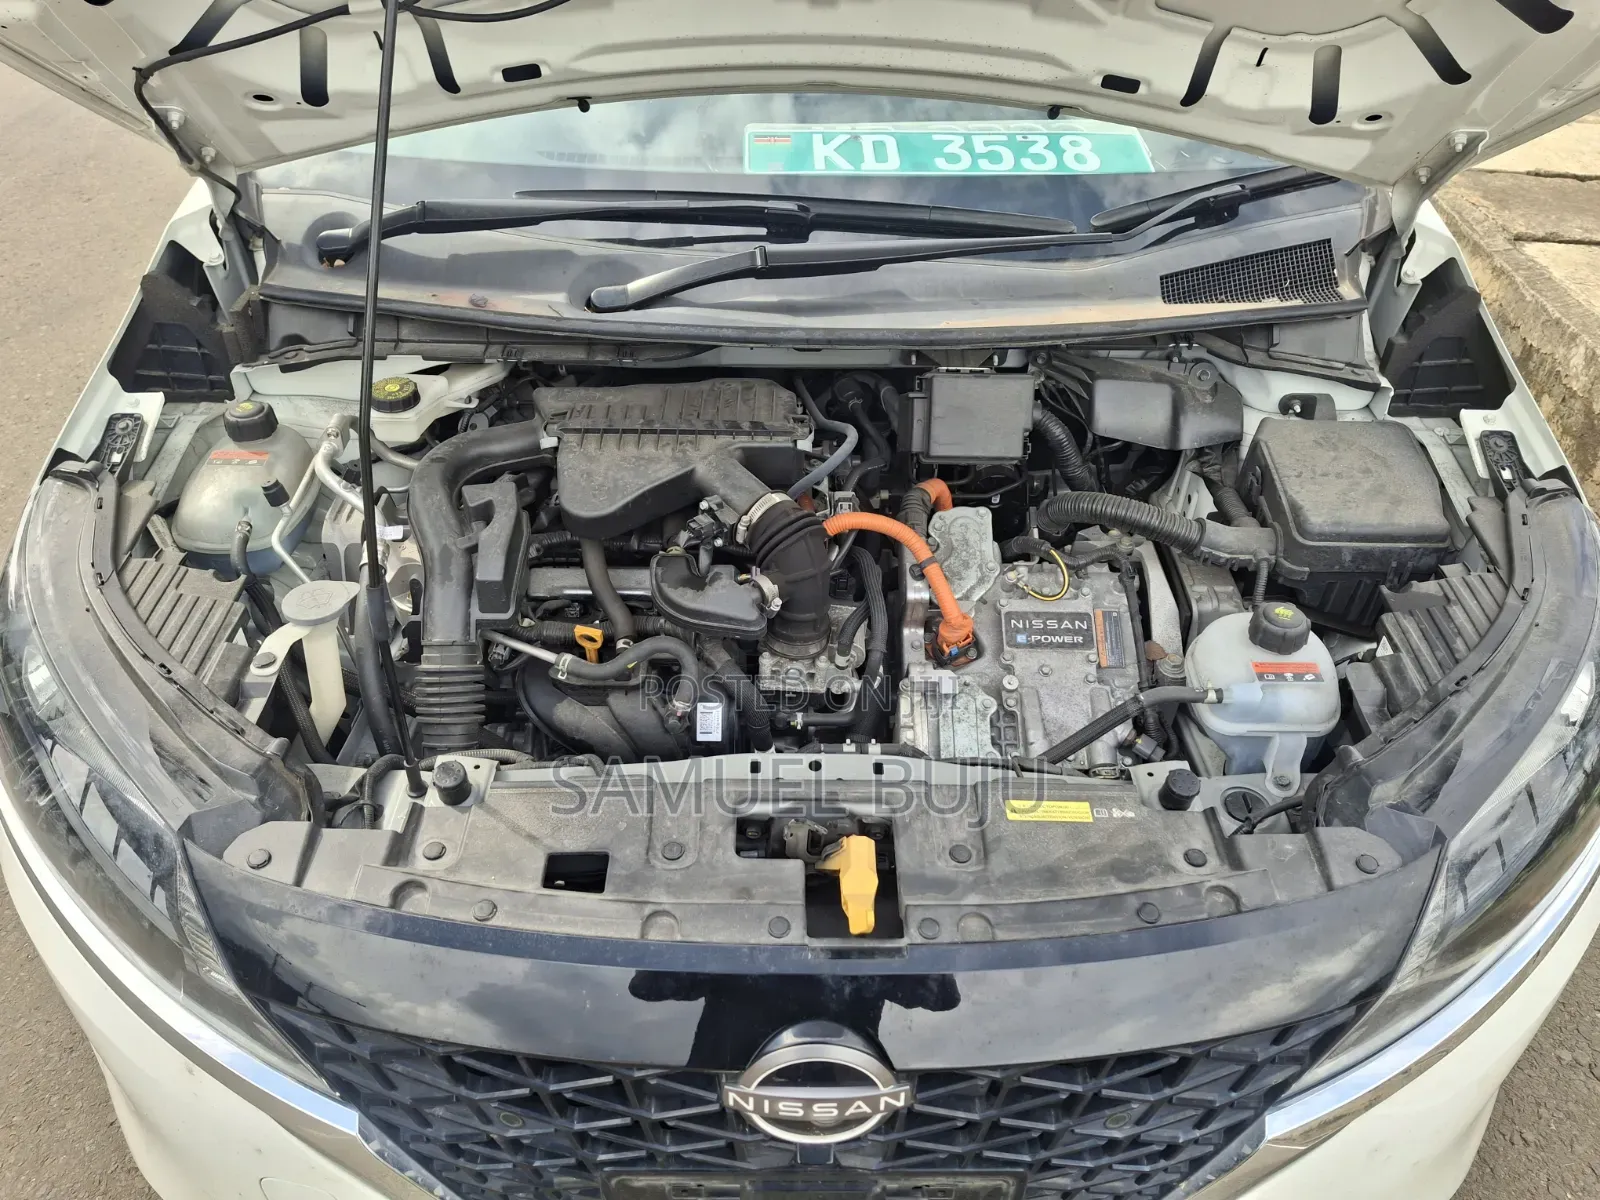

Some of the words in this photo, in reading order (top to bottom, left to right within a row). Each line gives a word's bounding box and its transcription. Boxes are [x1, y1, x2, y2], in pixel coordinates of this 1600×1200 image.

[812, 133, 900, 171] KD
[931, 134, 1101, 172] 3538
[1010, 619, 1088, 630] NISSAN
[728, 1092, 906, 1117] NISSAN
